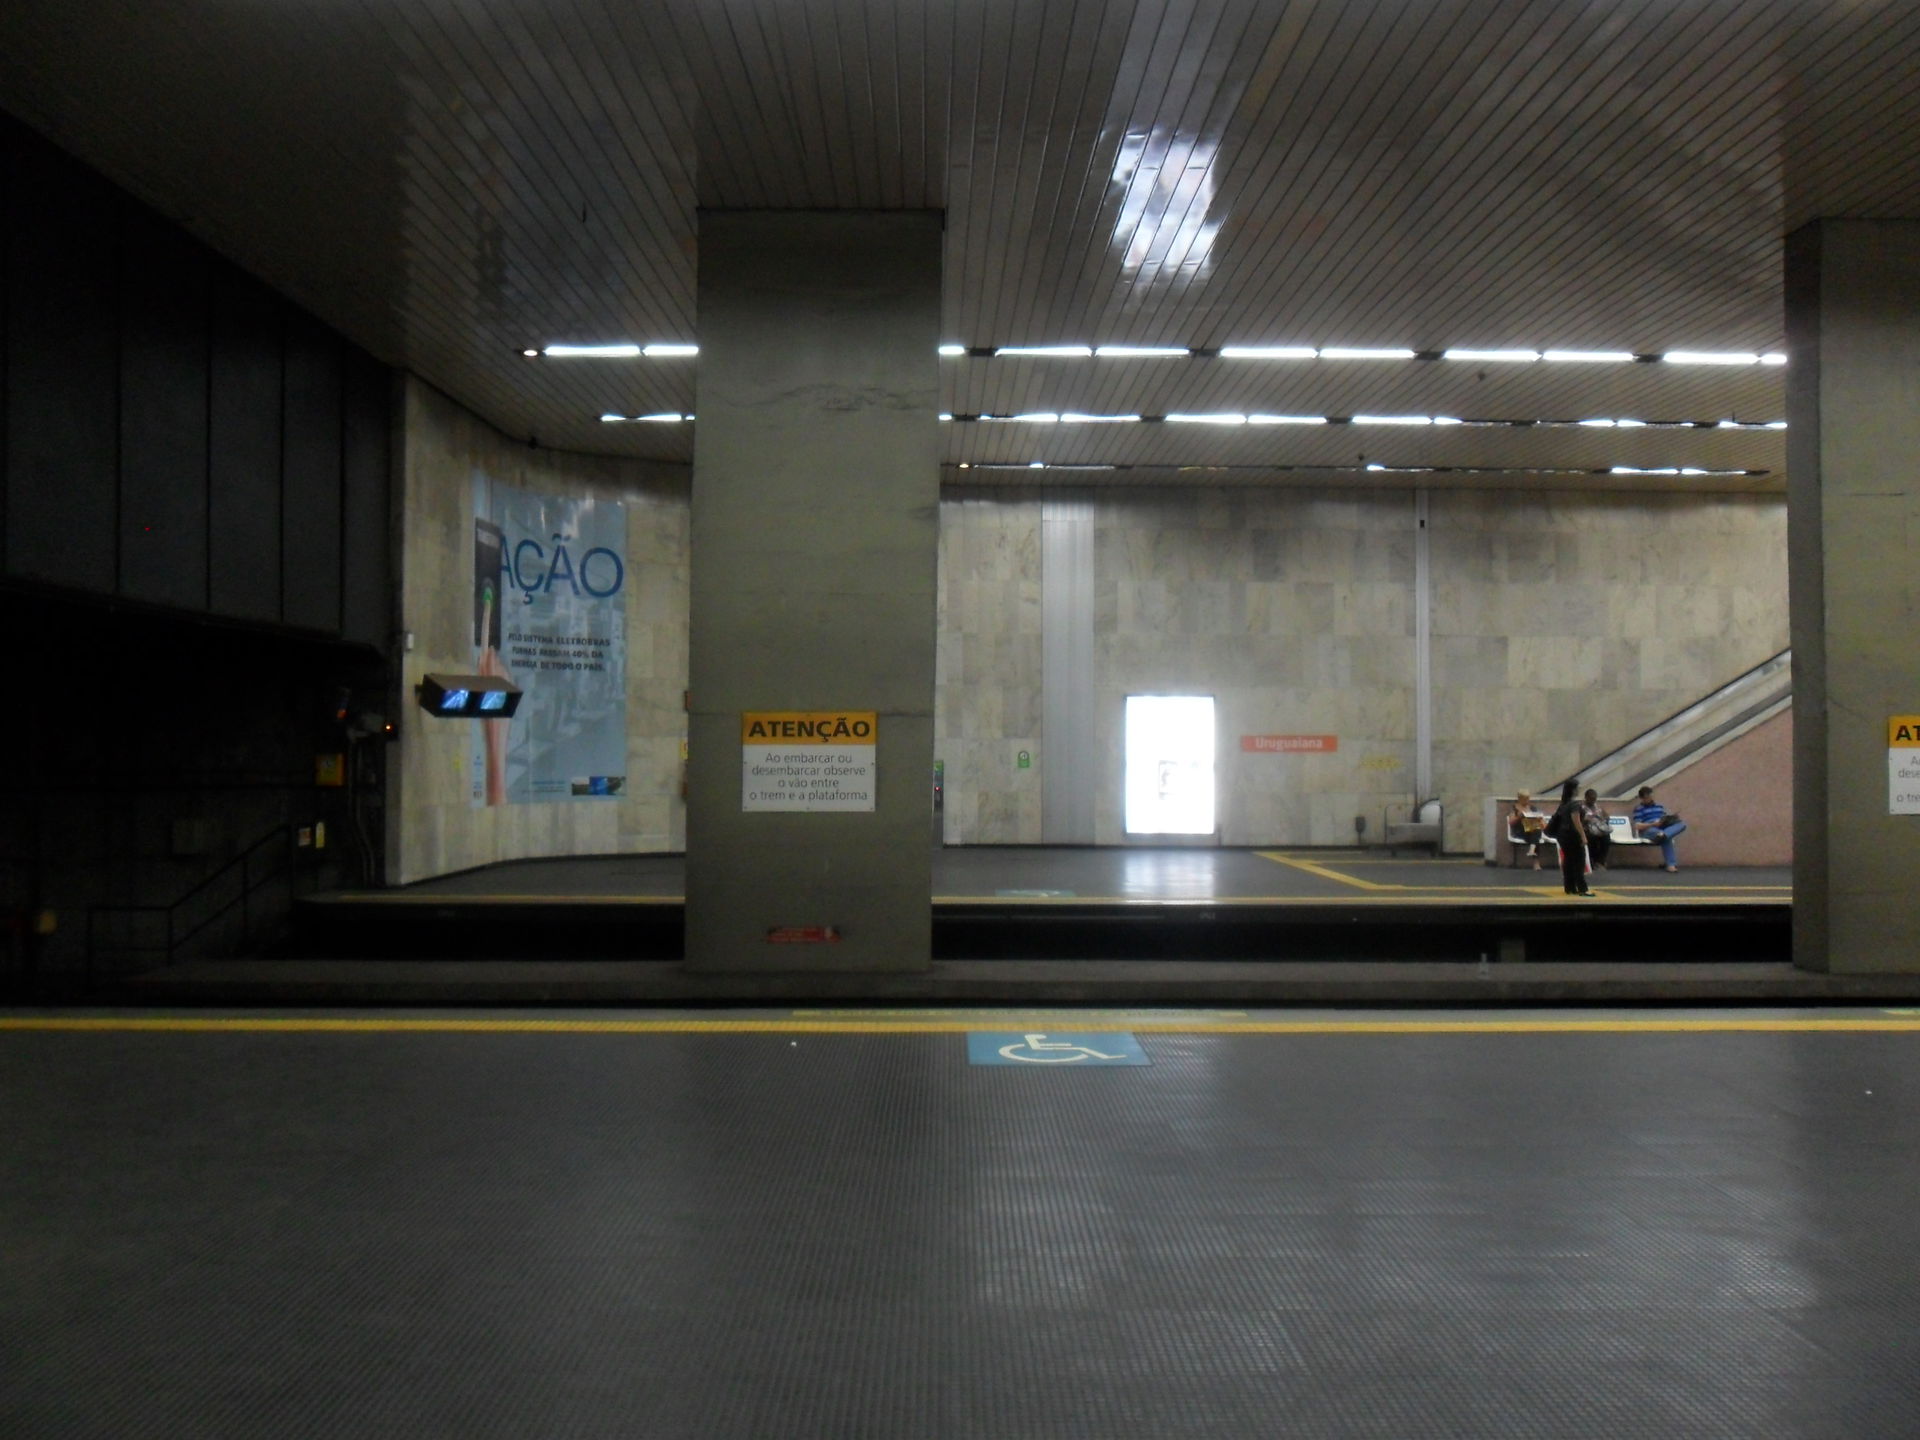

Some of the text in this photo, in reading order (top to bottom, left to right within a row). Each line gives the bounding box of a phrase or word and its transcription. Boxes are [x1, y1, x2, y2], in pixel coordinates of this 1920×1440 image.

[749, 717, 870, 742] ATENÇÃO
[1256, 737, 1322, 750] Uruguaiana
[765, 752, 781, 763] Ao
[784, 752, 834, 763] embarcar
[752, 765, 866, 776] desembarcar observe
[778, 778, 839, 788] o vão entre
[749, 790, 867, 802] o trem e a plataforma
